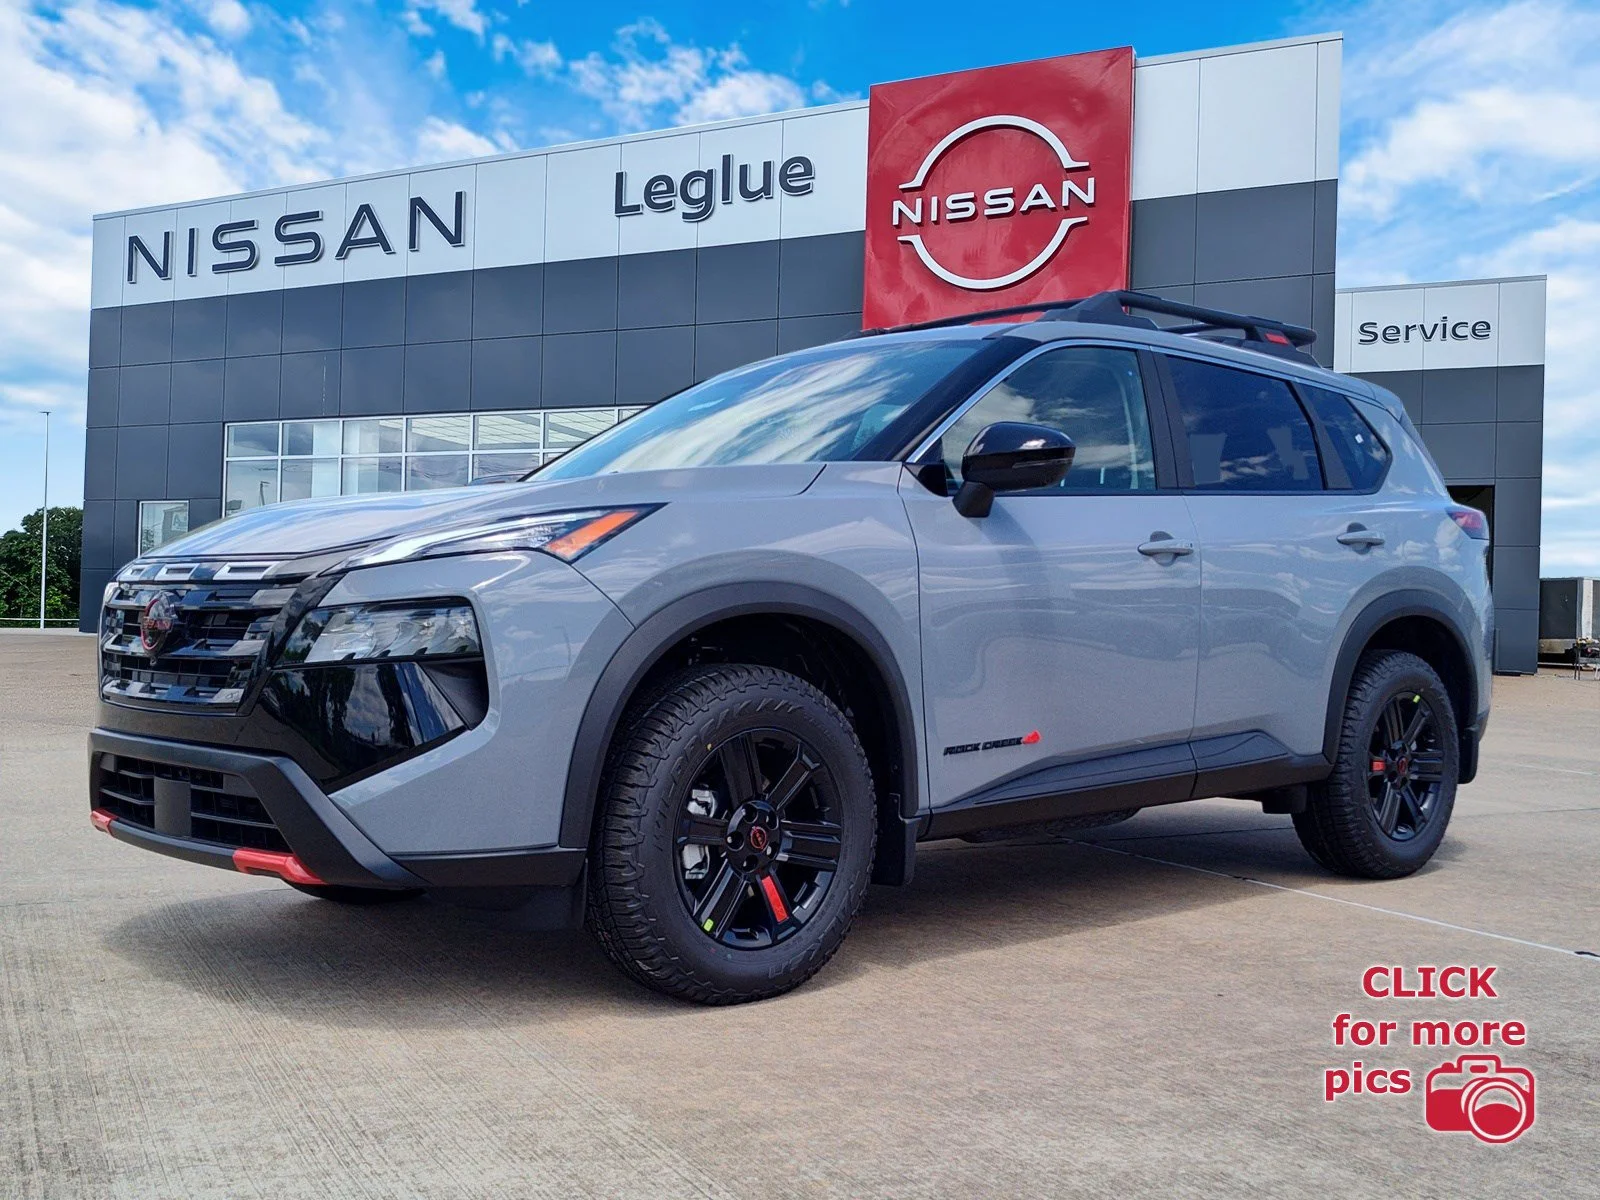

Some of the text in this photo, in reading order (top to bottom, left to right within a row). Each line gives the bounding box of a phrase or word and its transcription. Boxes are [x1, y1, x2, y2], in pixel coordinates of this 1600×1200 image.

[614, 154, 815, 222] Leglue
[892, 175, 1095, 227] NISSAN
[127, 190, 467, 284] NISSAN
[1358, 316, 1491, 344] Service
